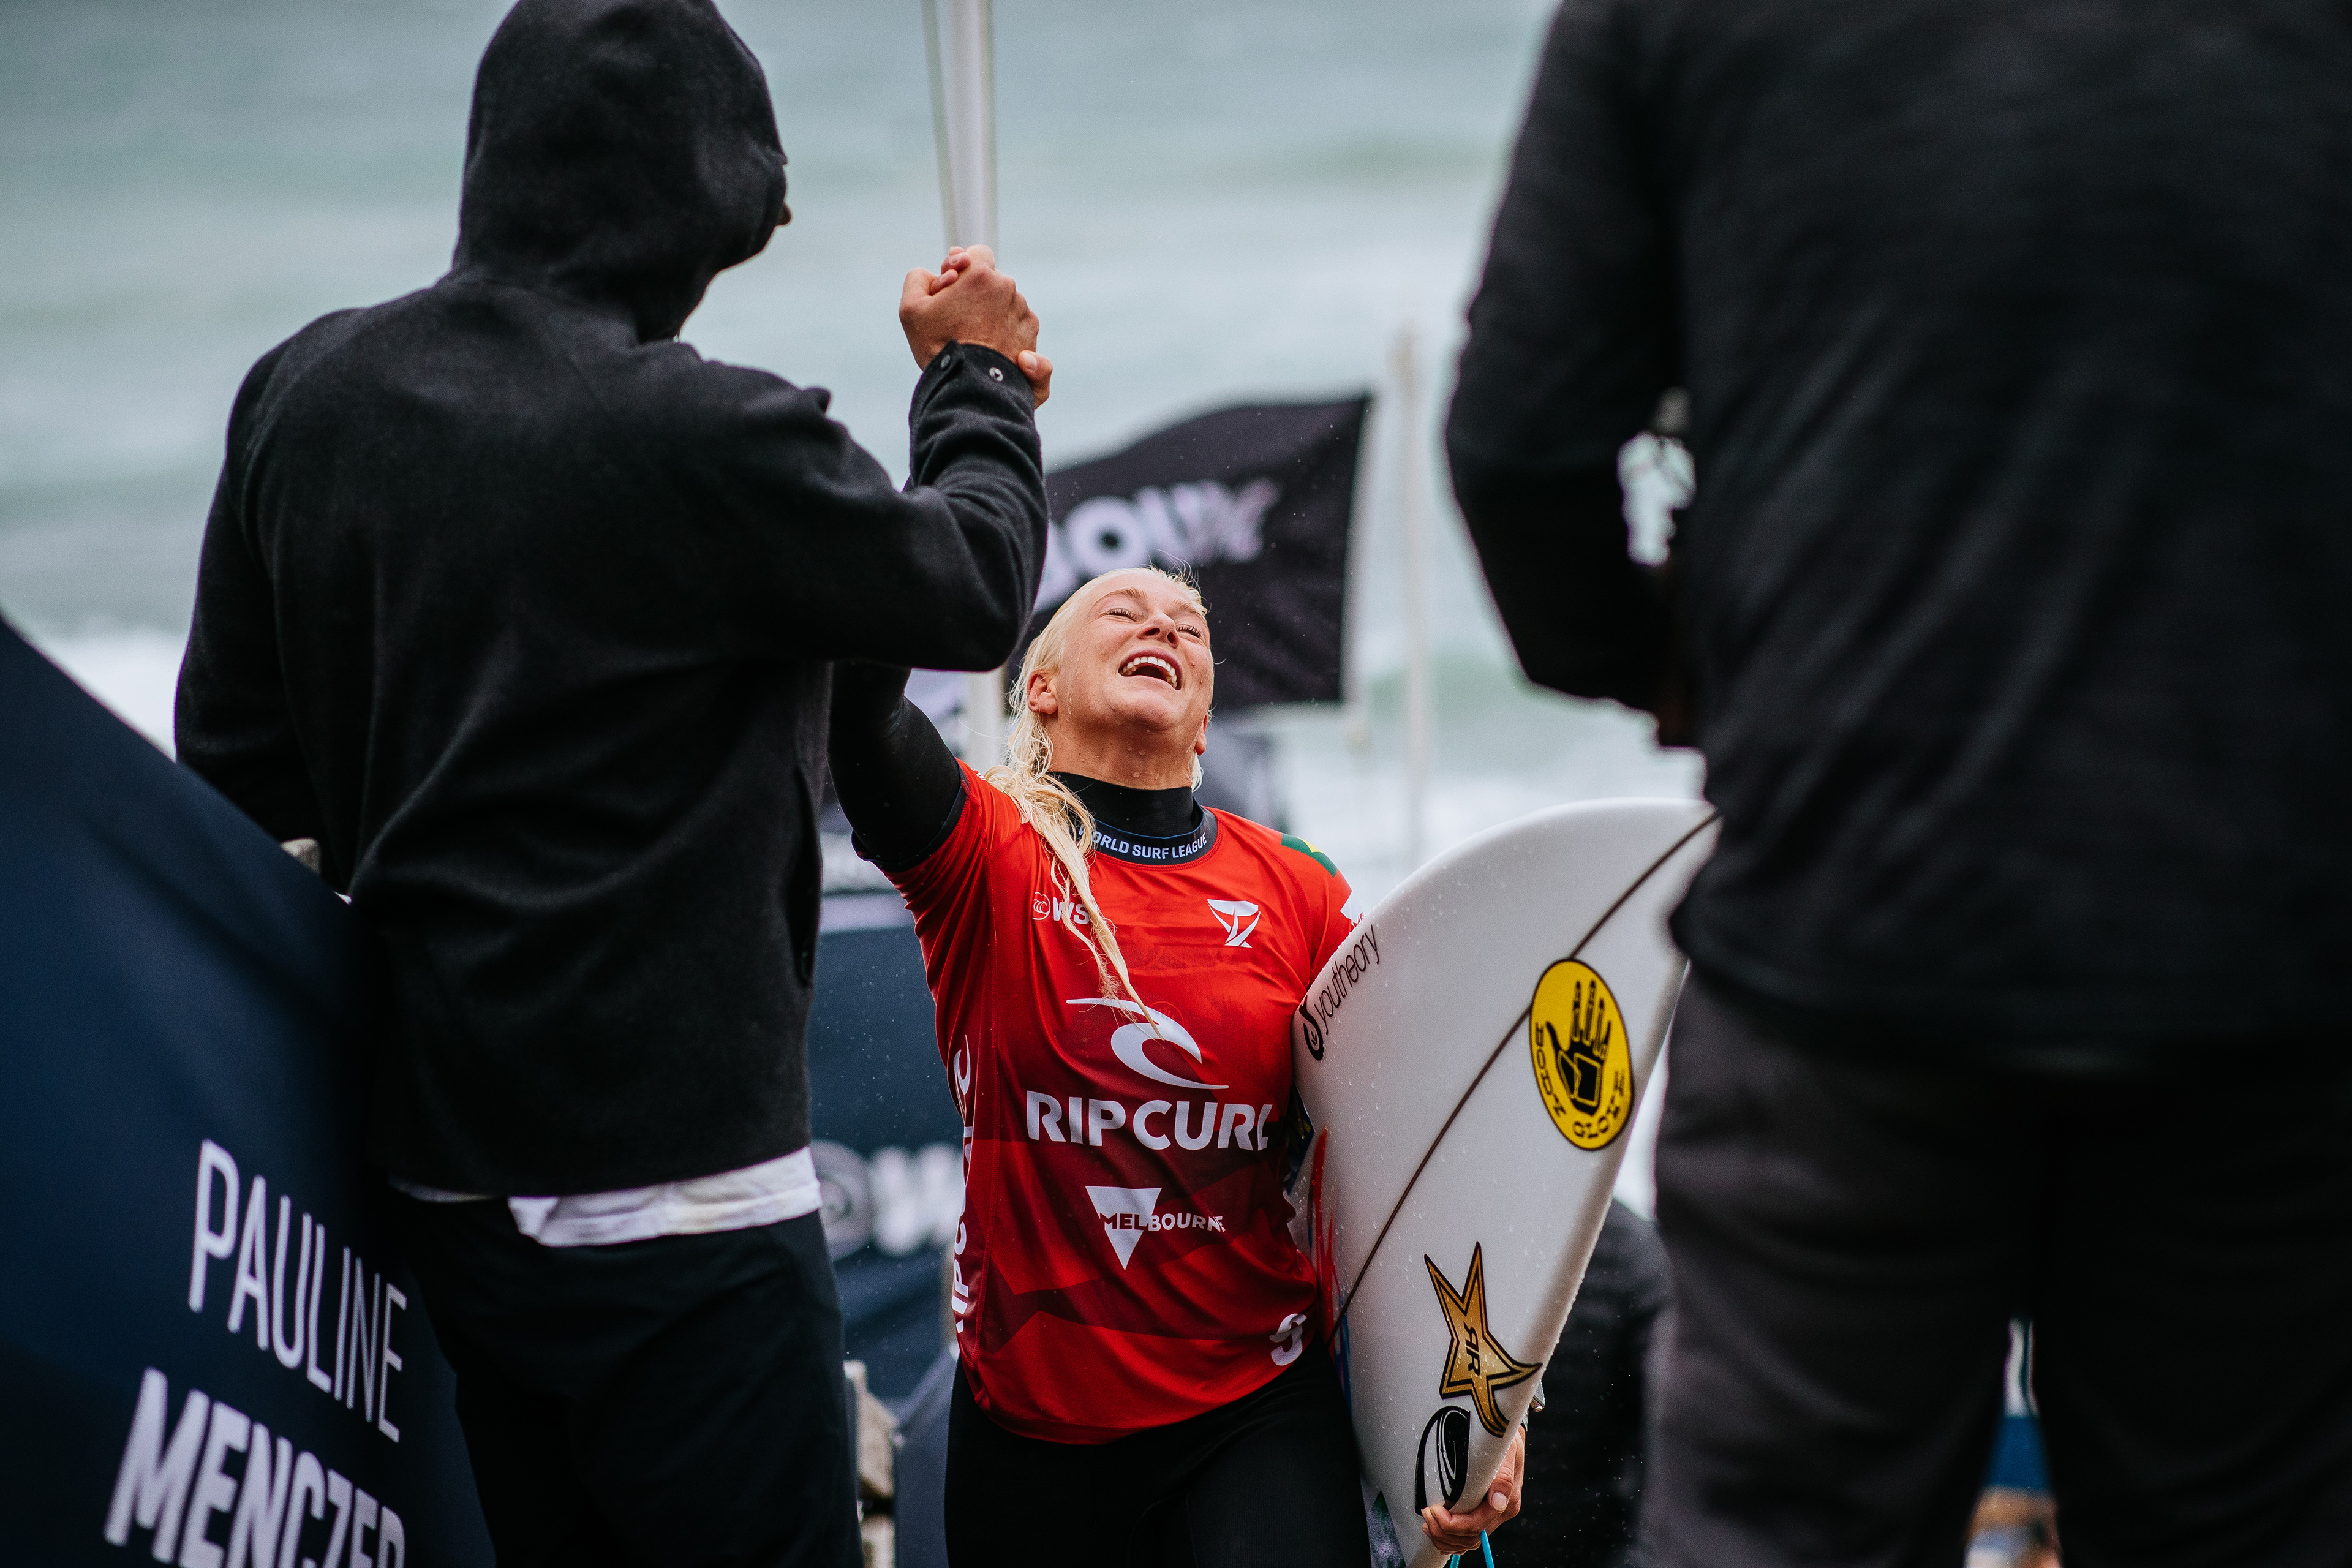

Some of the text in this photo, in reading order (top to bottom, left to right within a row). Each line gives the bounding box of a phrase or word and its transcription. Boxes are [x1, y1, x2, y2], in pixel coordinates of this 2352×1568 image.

[1078, 824, 1207, 859] ORLD SURF LEAGUE
[1053, 897, 1107, 925] WS
[1314, 924, 1380, 1036] youtheory
[1535, 1022, 1624, 1139] BODY GLOVE
[188, 1139, 407, 1444] PAULINE
